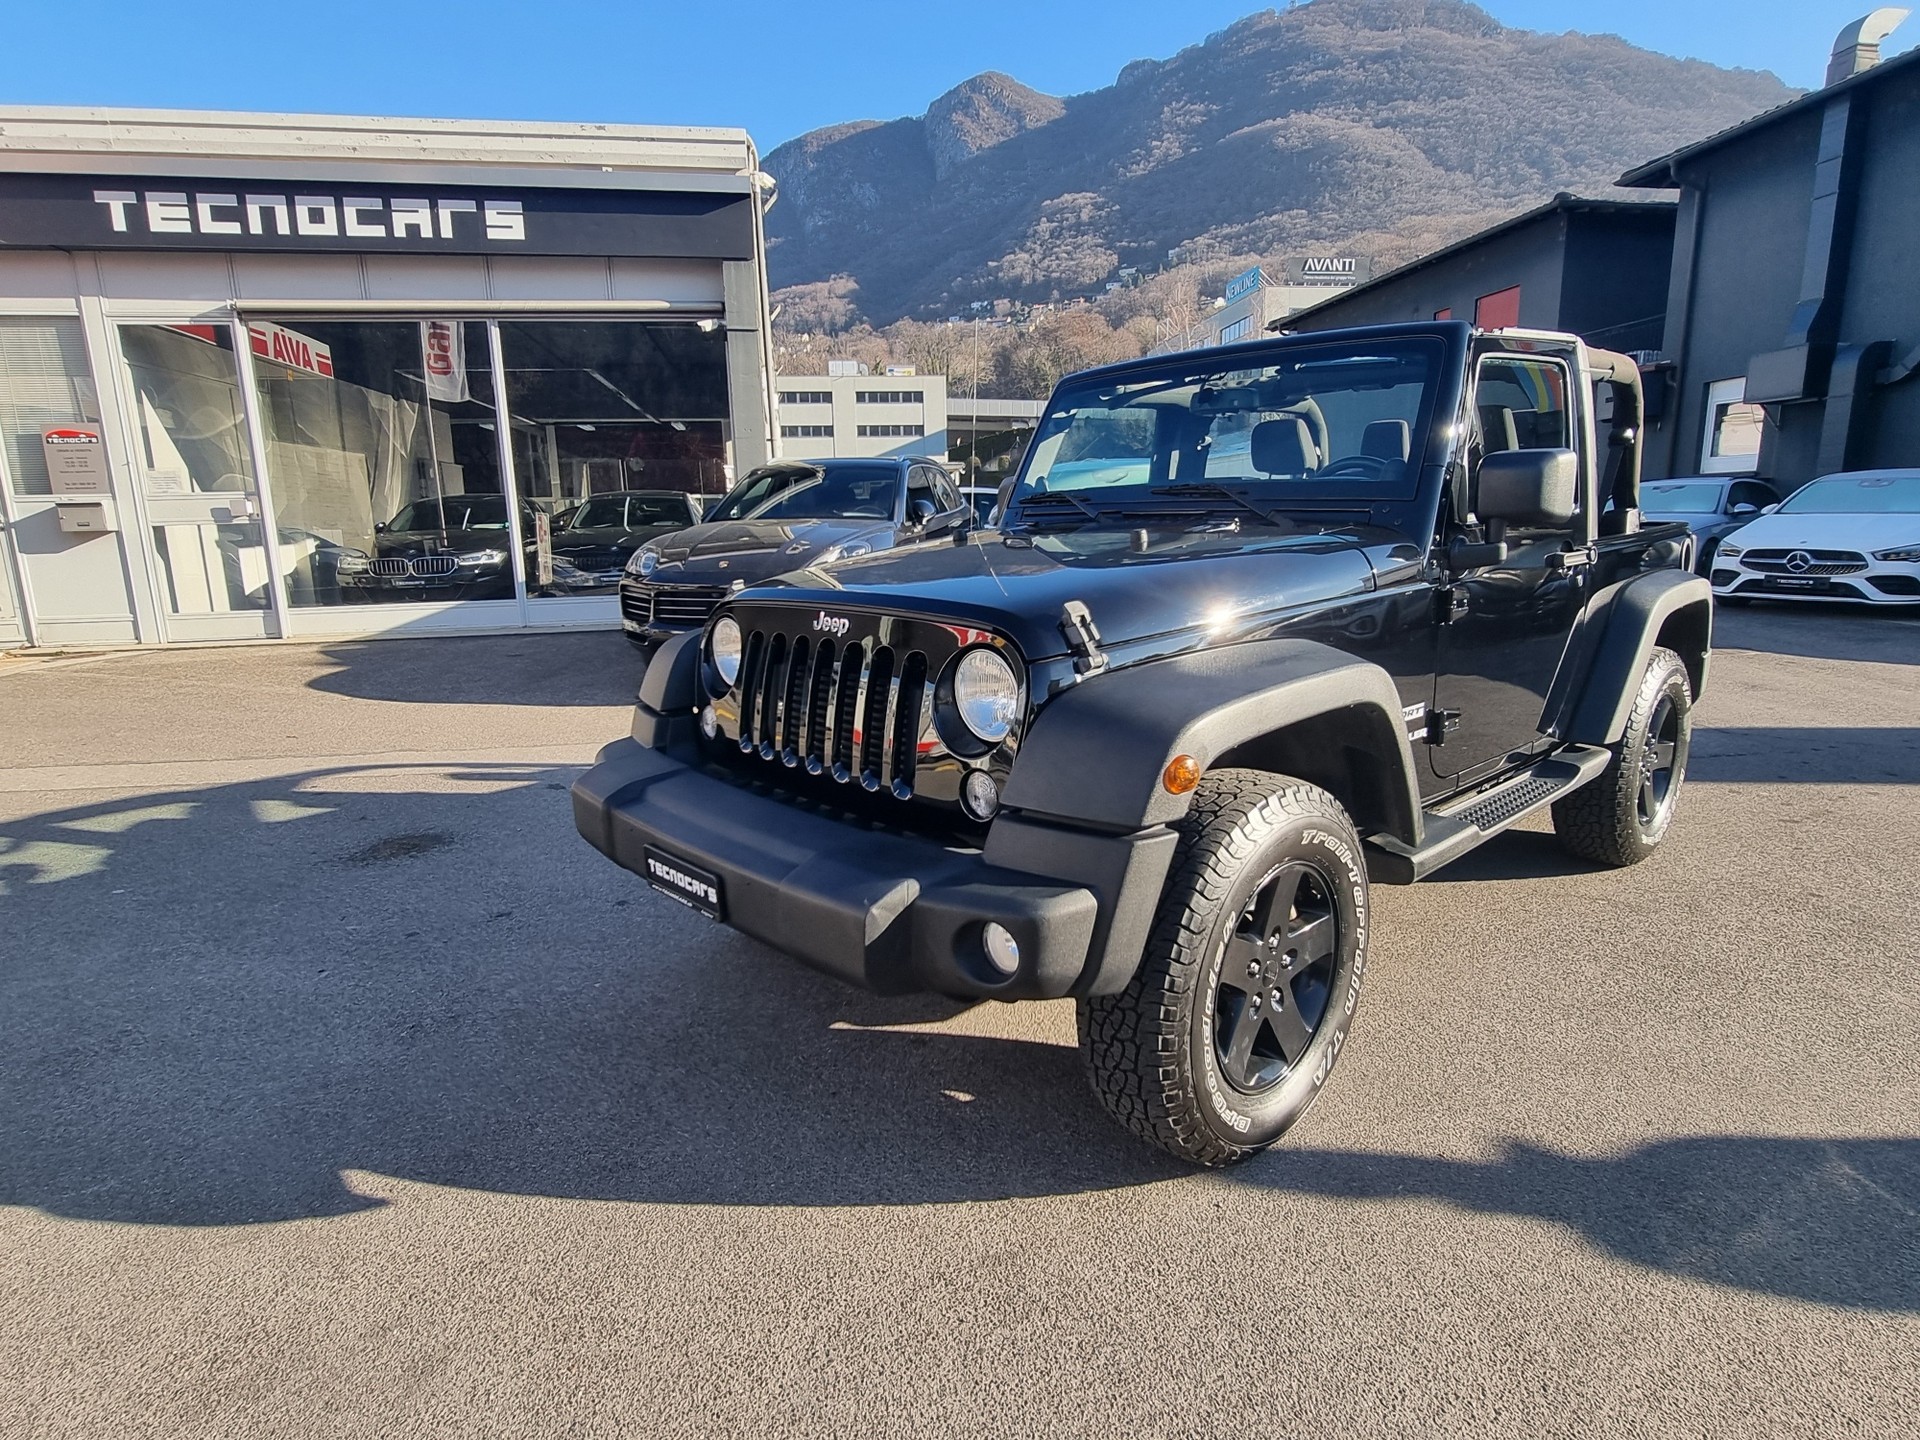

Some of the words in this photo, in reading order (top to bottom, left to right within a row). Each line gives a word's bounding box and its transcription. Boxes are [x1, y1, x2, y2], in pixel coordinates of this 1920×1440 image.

[93, 190, 526, 241] TECNOCARS
[1304, 258, 1356, 271] AVANTI
[1225, 272, 1257, 301] NEWLINE
[812, 610, 850, 638] Jeep
[1402, 705, 1425, 719] ORT
